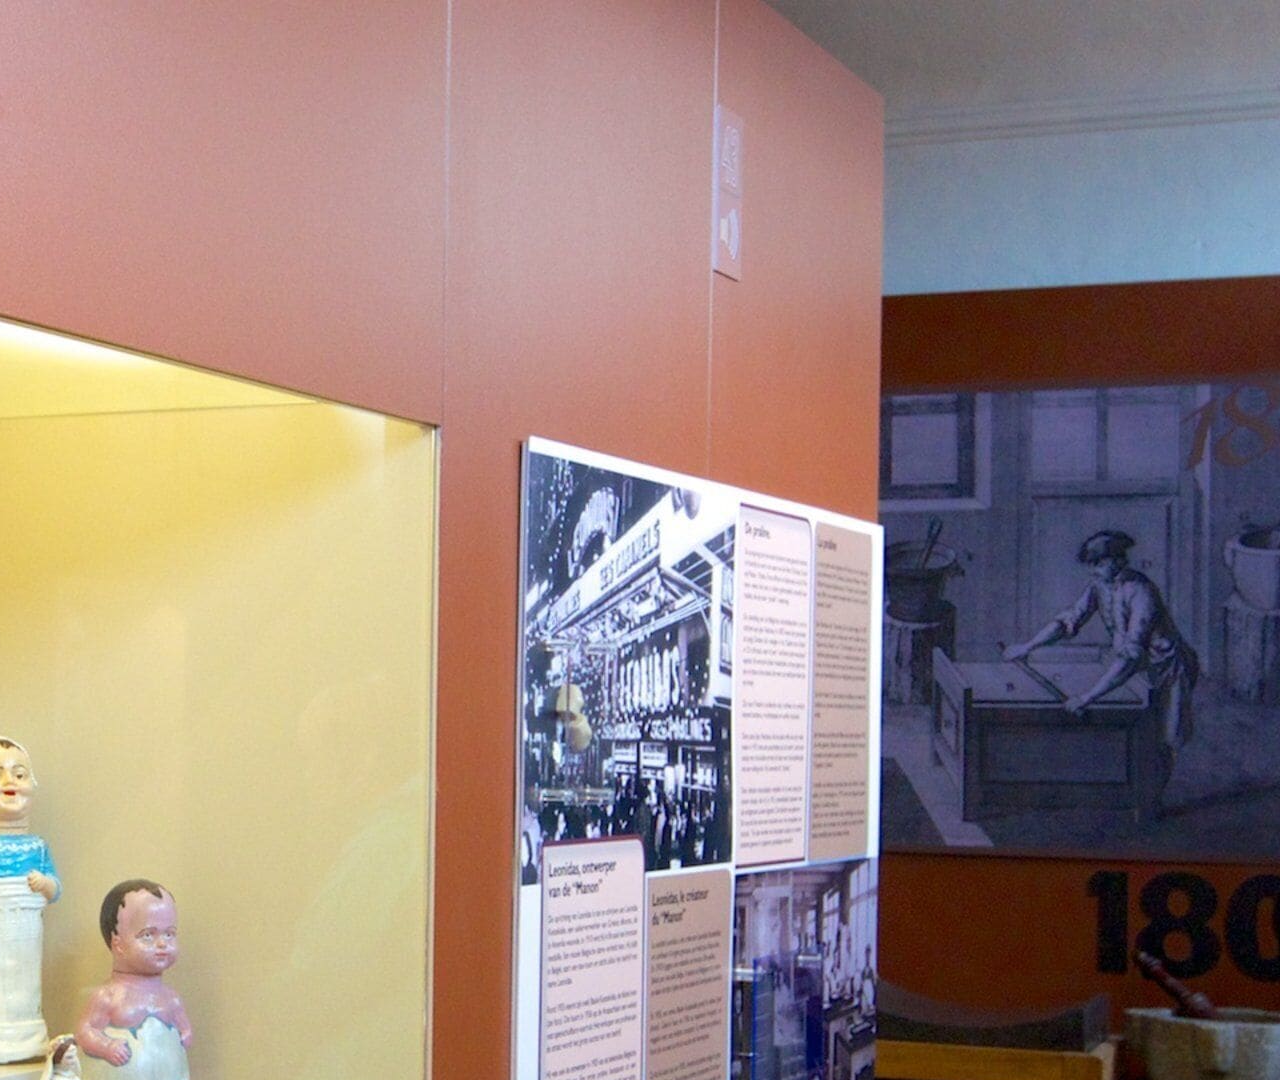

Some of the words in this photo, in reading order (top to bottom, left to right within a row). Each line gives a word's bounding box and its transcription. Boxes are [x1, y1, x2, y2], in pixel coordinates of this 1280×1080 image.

[549, 860, 581, 878] Leonidas,
[582, 860, 616, 876] ontwerper
[549, 887, 561, 898] van
[562, 883, 571, 897] de
